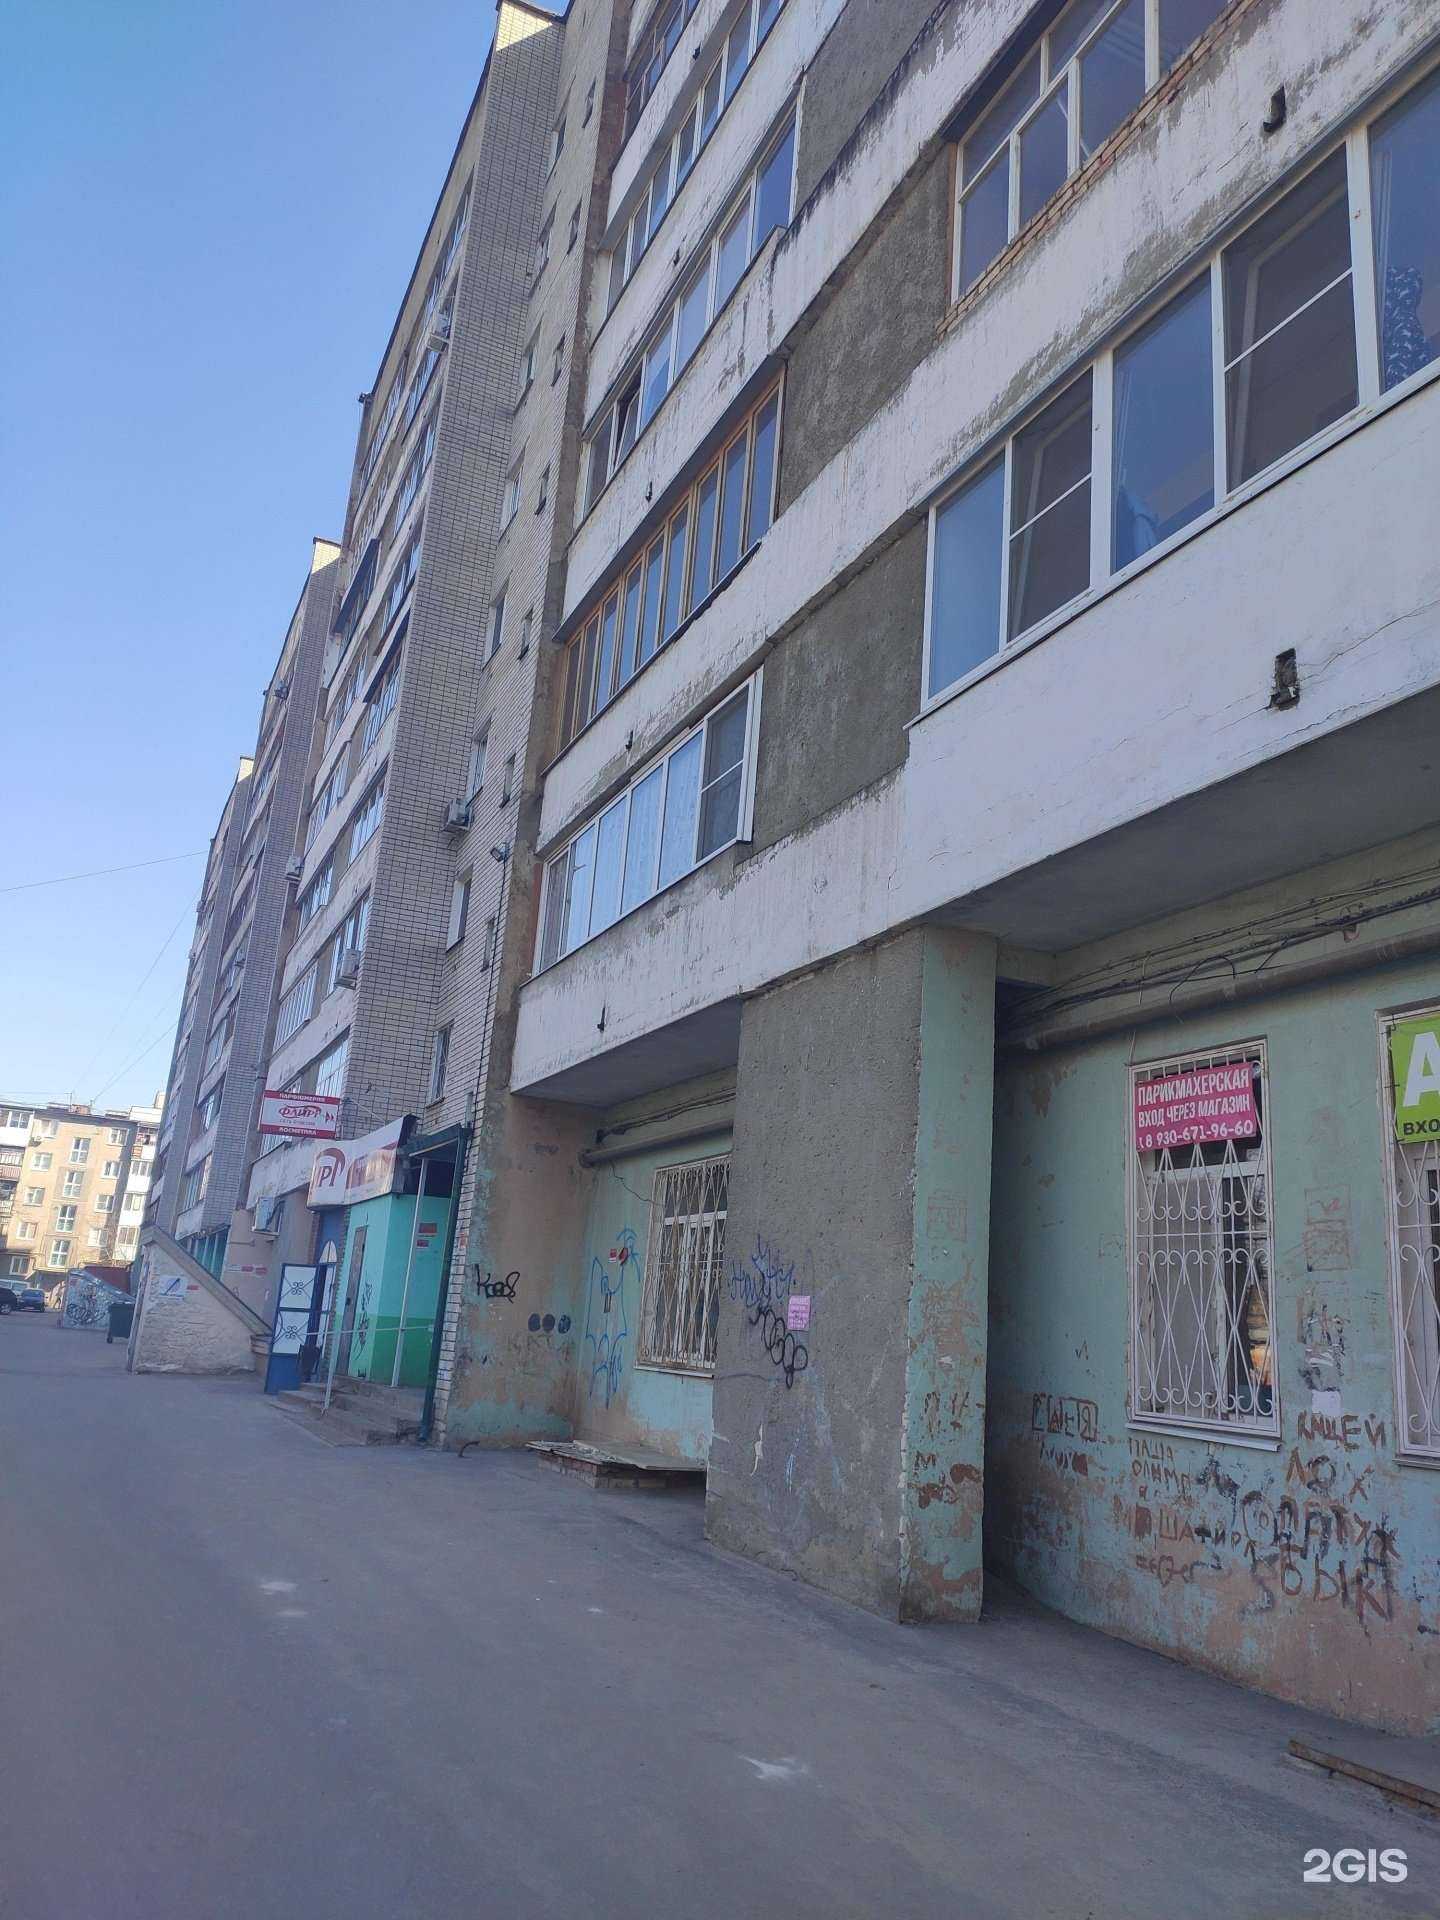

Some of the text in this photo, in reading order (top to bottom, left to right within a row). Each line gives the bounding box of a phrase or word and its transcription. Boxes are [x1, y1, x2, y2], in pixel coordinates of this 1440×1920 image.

[1138, 1068, 1250, 1106] ПАРИКМАХЕРСКАЯ
[1138, 1094, 1250, 1128] ВХОД ЧЕРЕЗ МАГАЗИН
[1157, 1119, 1253, 1146] 930-671-96-60
